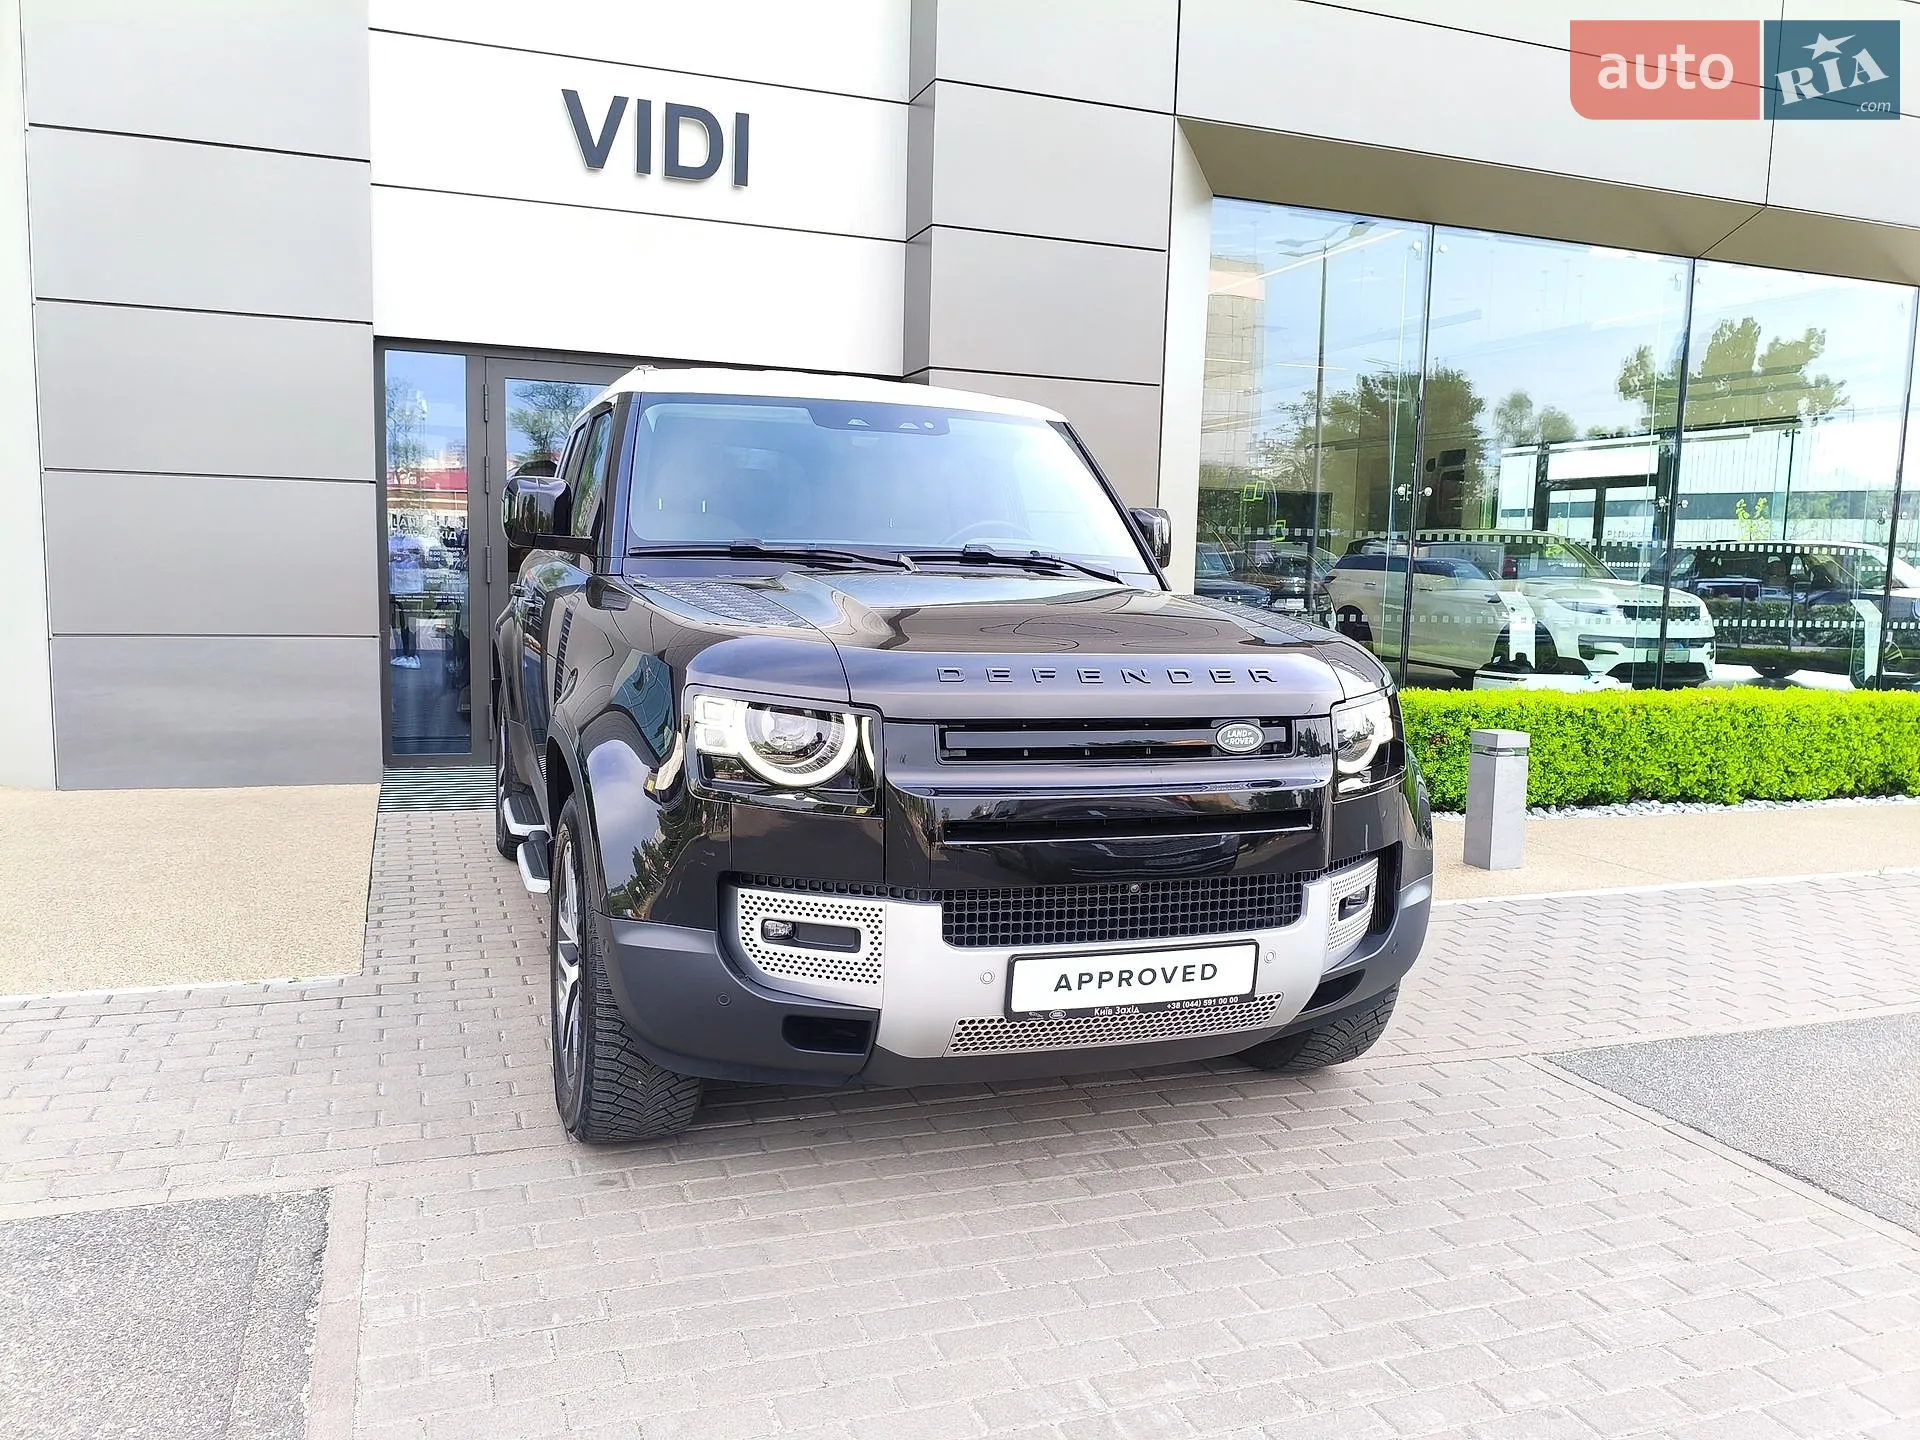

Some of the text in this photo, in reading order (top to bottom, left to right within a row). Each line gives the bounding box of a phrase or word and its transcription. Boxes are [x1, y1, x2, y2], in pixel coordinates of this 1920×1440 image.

[561, 88, 749, 187] VIDI
[936, 666, 1278, 684] DEFENDER
[1226, 730, 1248, 738] LAND
[1229, 737, 1254, 745] ROVER
[1054, 963, 1218, 992] APPROVED
[1166, 1001, 1181, 1010] +38
[1182, 998, 1202, 1009] (044)
[1229, 996, 1239, 1004] 00
[1094, 1005, 1140, 1016] Київ Захід
